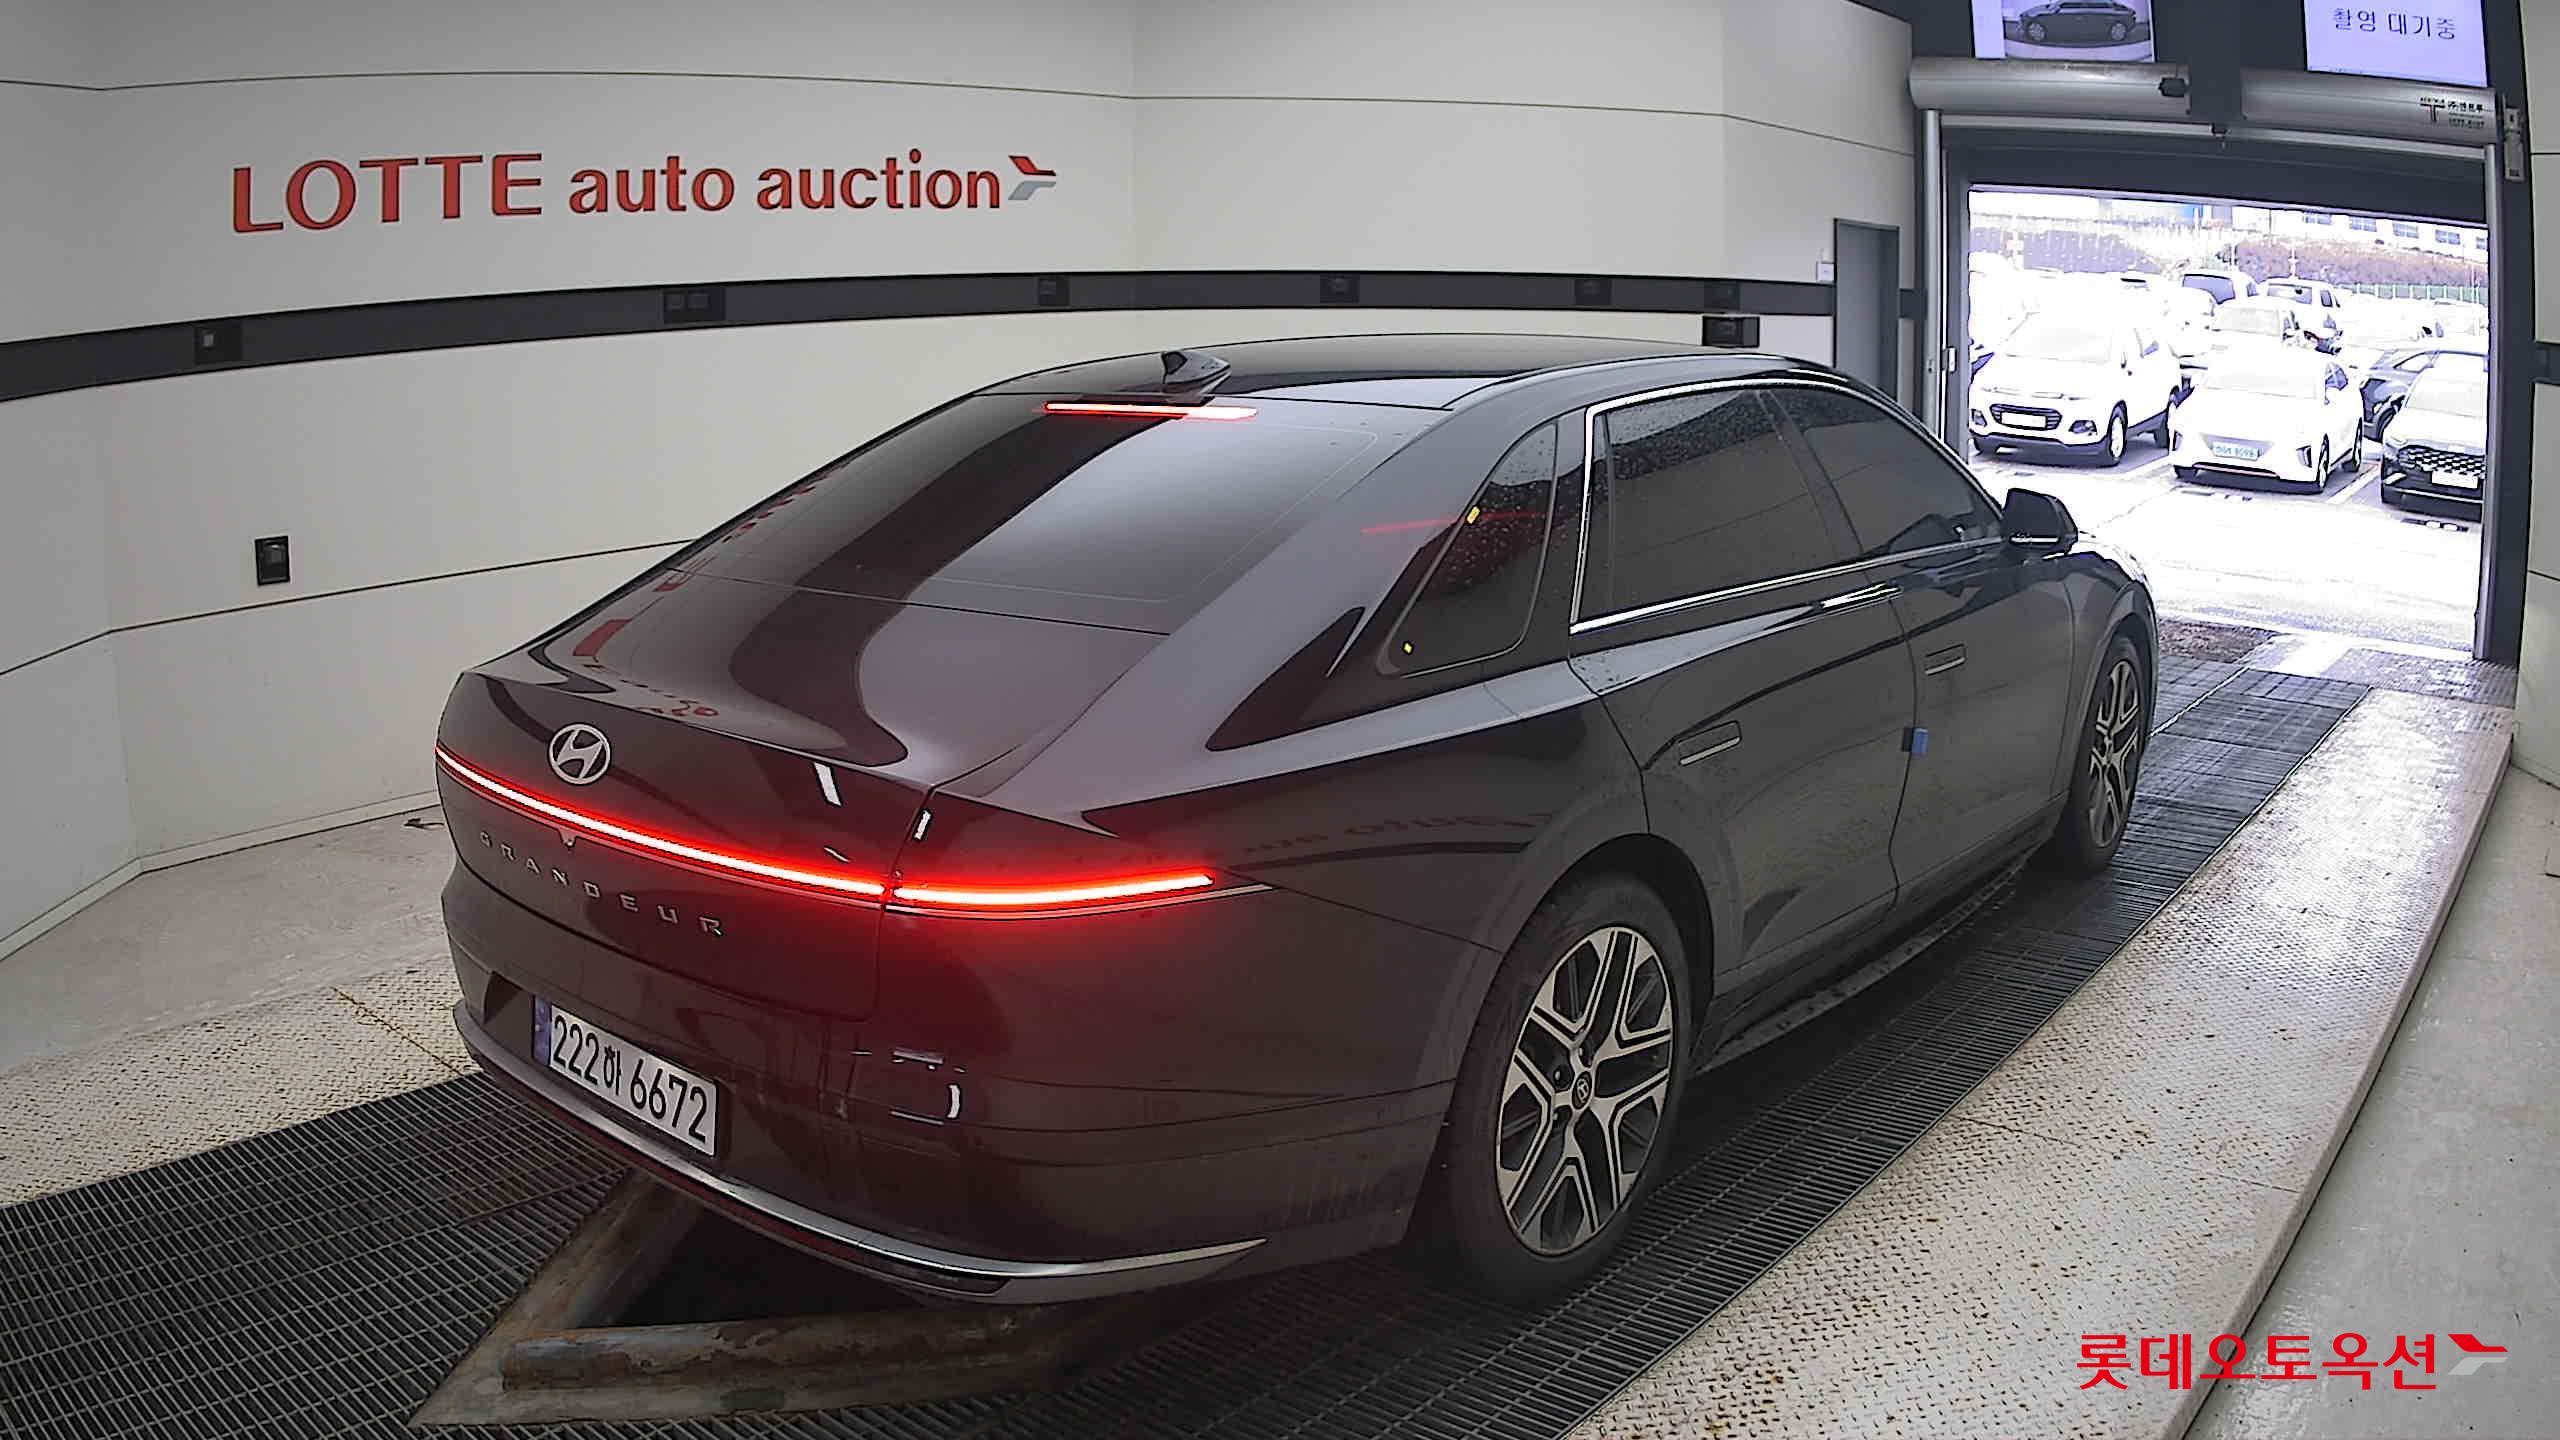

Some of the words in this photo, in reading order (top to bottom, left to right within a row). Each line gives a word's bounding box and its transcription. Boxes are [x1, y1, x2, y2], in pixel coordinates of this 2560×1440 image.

[2333, 8, 2377, 33] 촬영
[2387, 13, 2457, 41] 대기중
[233, 153, 542, 233] LOTTE
[568, 155, 735, 214] auto
[757, 148, 1001, 210] auction
[479, 831, 724, 937] GRANDEUR
[630, 1057, 707, 1145] 6672
